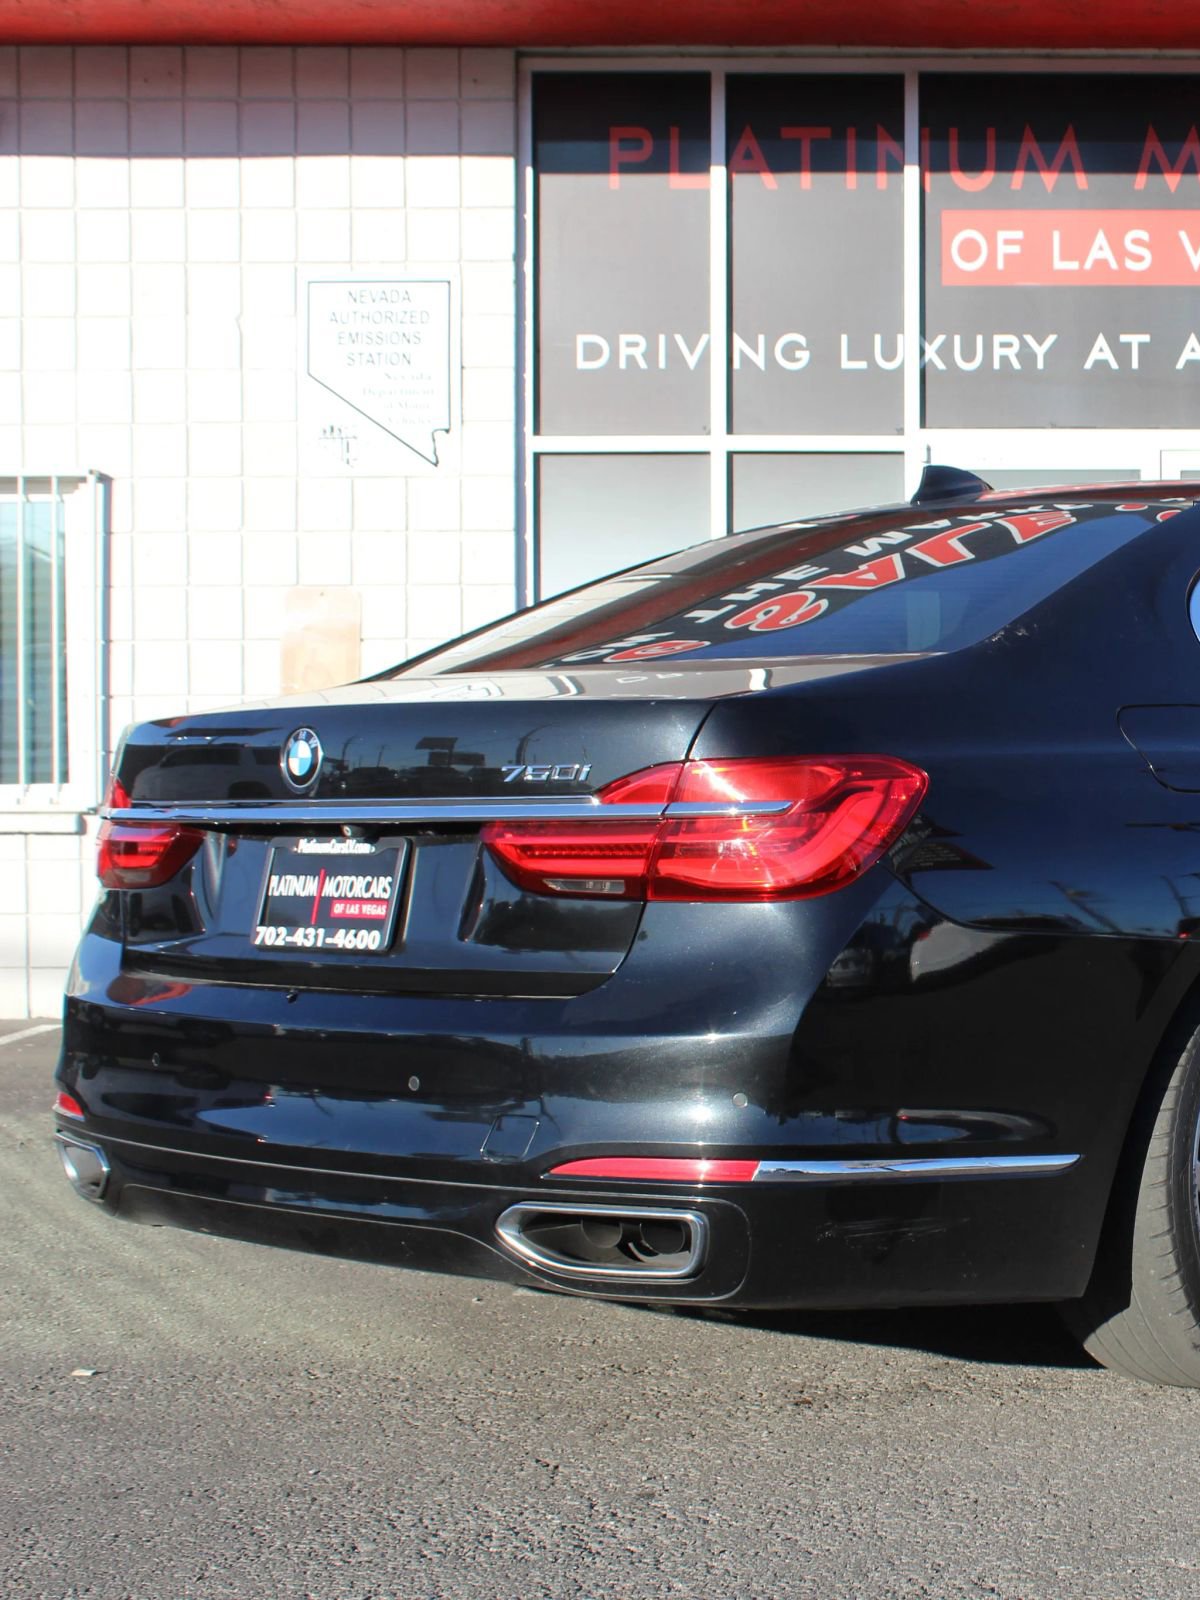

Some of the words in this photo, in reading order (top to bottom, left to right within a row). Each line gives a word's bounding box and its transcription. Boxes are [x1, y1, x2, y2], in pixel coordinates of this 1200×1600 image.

[609, 123, 1088, 193] PLATINUM
[950, 229, 1024, 272] OF
[1052, 228, 1153, 272] LAS
[348, 289, 412, 303] NEVADA
[329, 310, 431, 325] AUTHORIZED
[337, 331, 422, 345] EMISSIONS
[346, 352, 412, 366] STATION
[575, 331, 811, 372] DRIVNG
[840, 332, 1058, 372] LUXURY
[1083, 332, 1151, 371] AT
[268, 874, 318, 897] PLATINUM
[321, 875, 392, 899] MOTORCARS
[333, 903, 345, 915] OF
[346, 903, 360, 915] LAS
[362, 903, 387, 916] VEGAS
[254, 926, 381, 950] 702-431-4600
